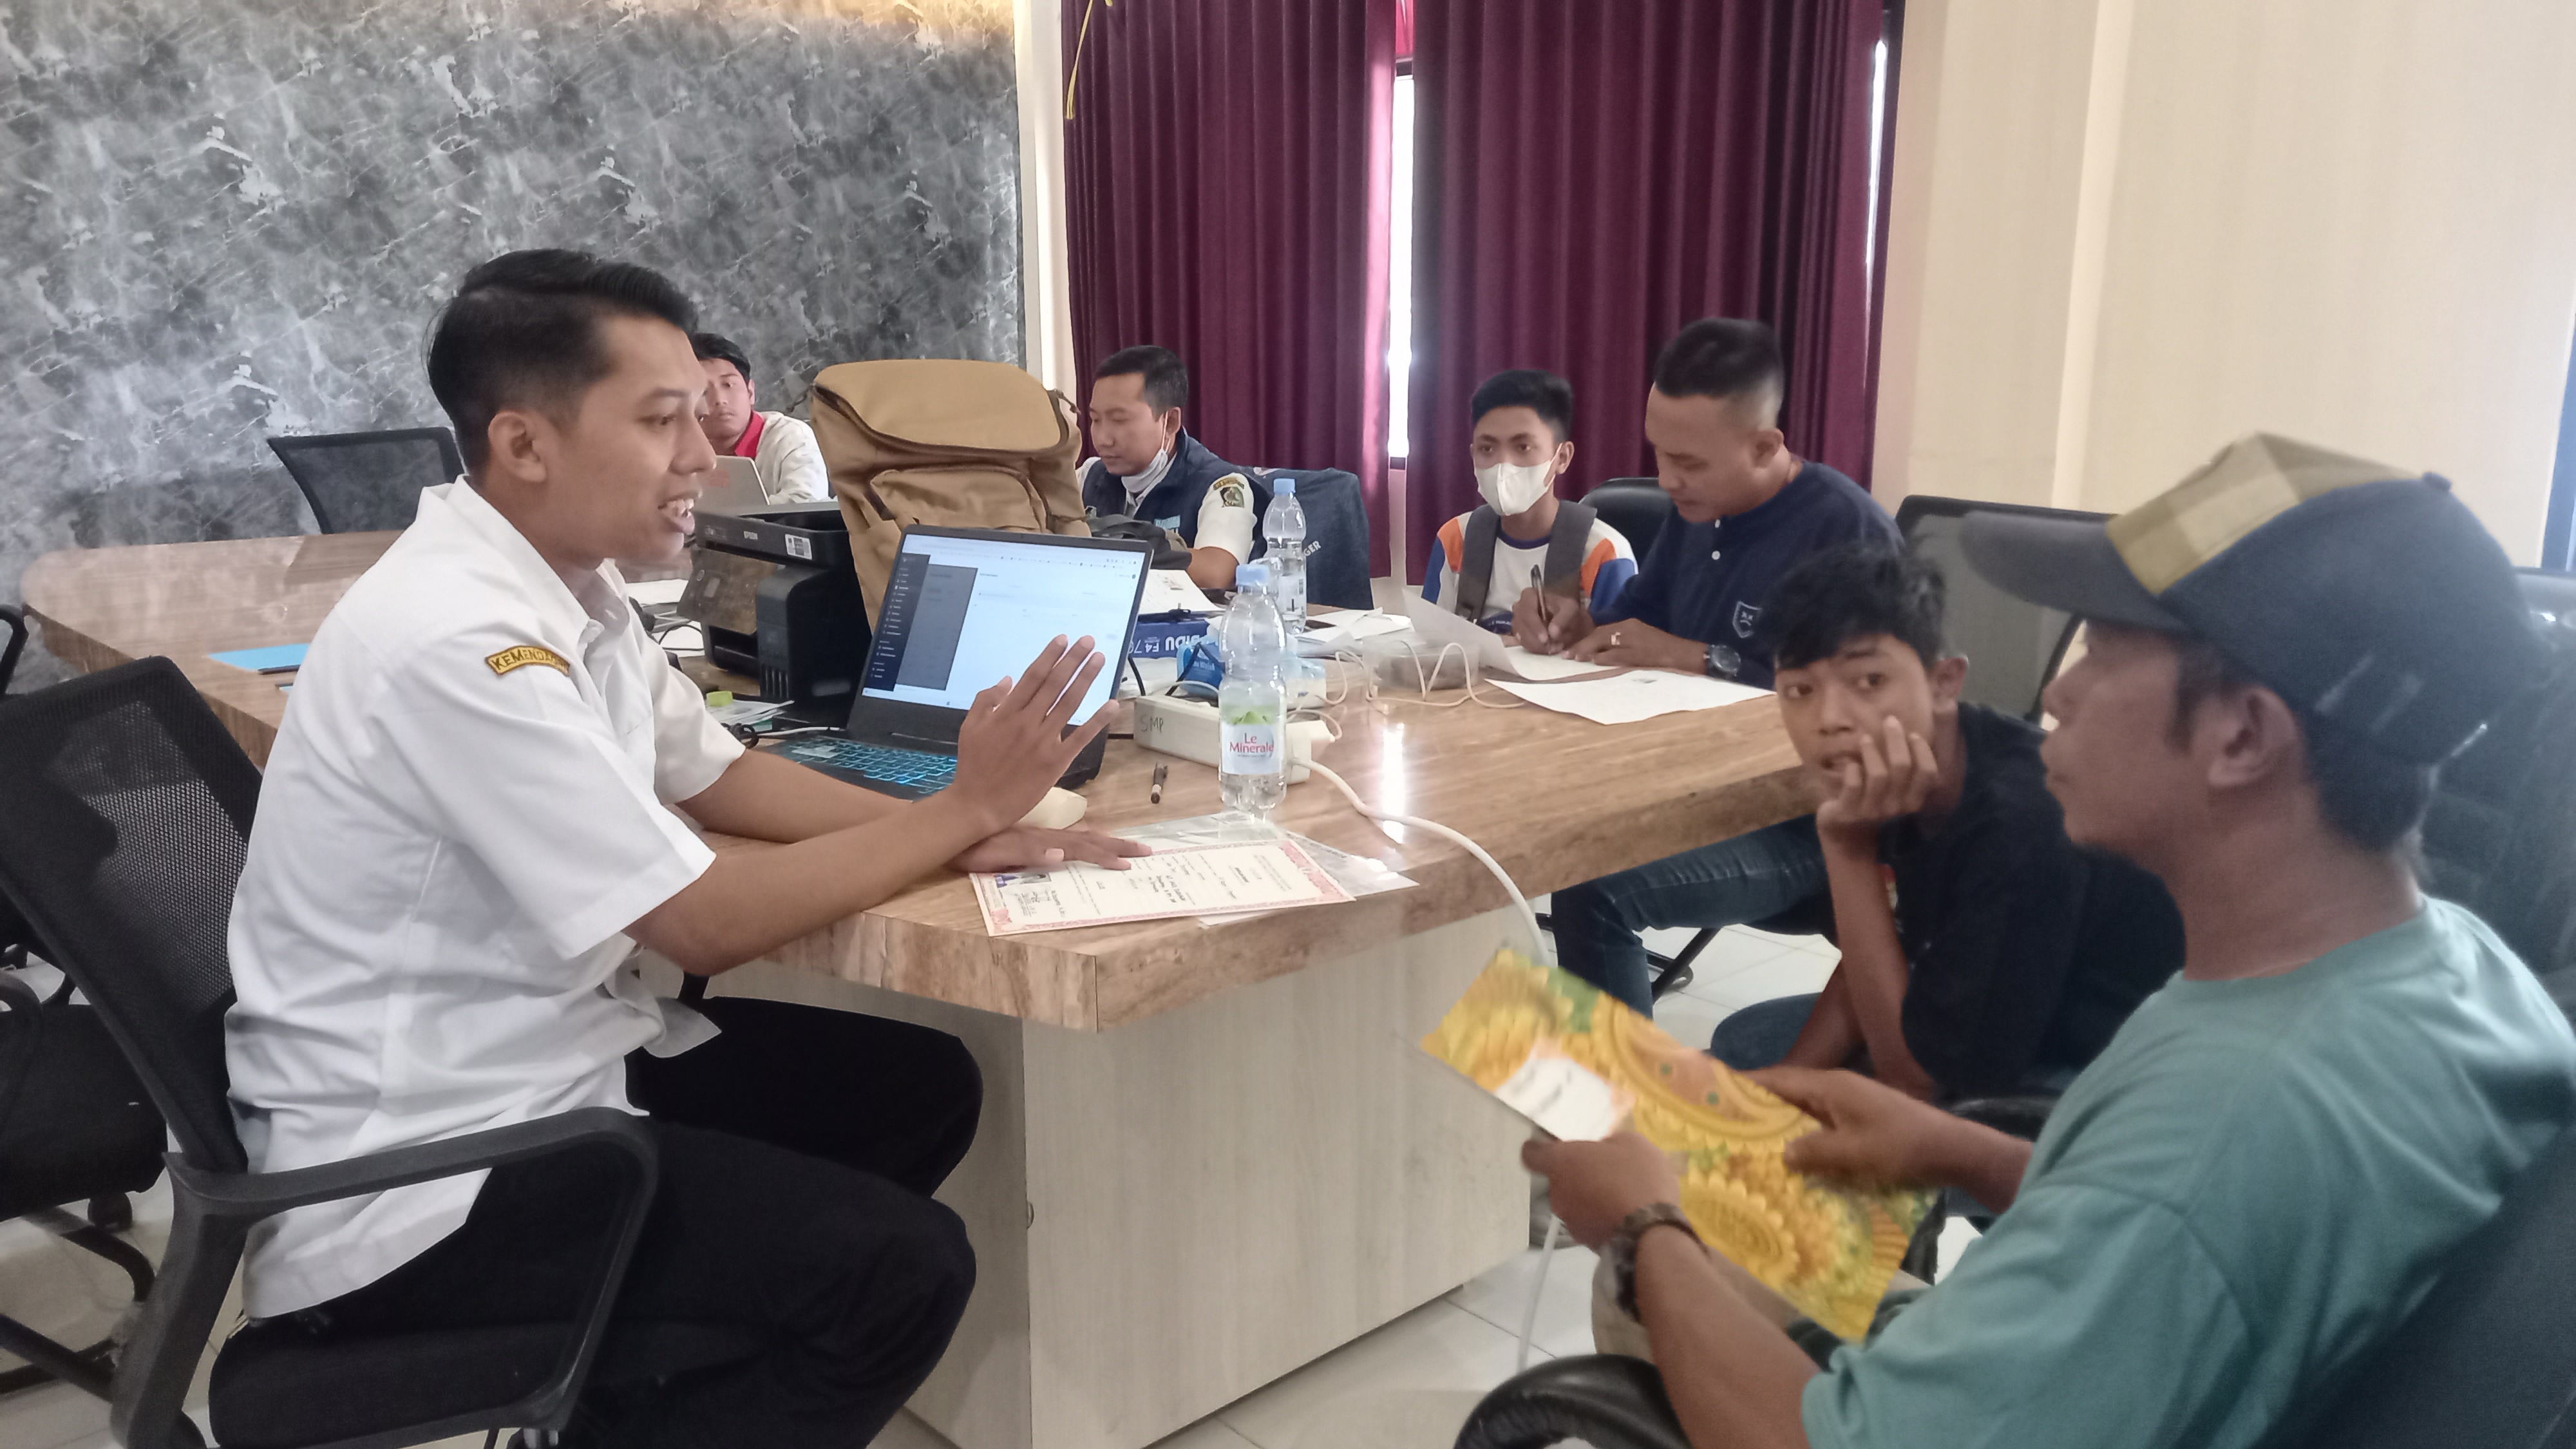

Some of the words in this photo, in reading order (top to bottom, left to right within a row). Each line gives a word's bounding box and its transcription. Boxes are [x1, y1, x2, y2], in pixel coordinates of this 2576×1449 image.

[1146, 643, 1159, 653] F4
[491, 649, 569, 672] KEMENDA
[1244, 732, 1257, 744] Le
[1229, 741, 1274, 753] Minerale
